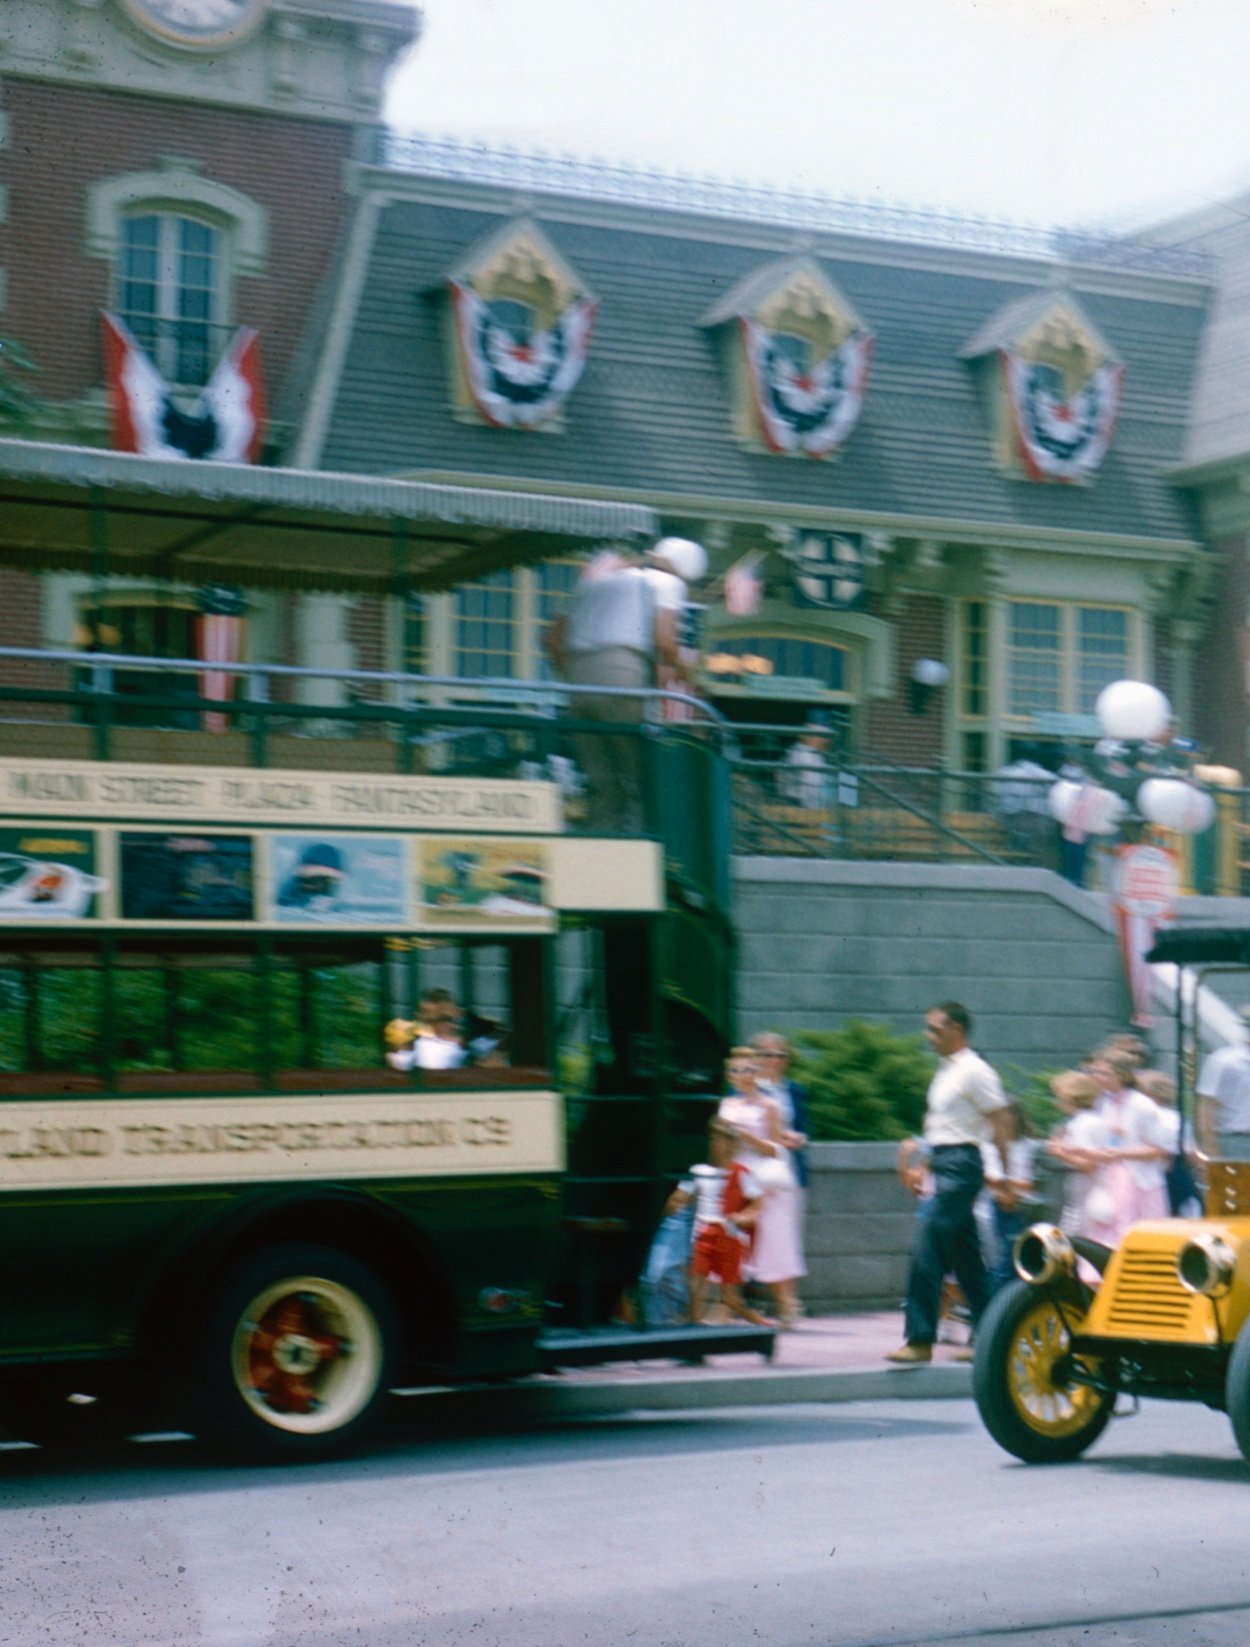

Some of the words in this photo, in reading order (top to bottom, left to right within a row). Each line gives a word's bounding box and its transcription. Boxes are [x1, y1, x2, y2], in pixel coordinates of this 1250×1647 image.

[9, 770, 86, 801] MAIN
[101, 773, 206, 807] STREET
[220, 779, 315, 811] PLAZA
[328, 783, 539, 819] FANTASYLAND
[118, 1120, 455, 1156] TRANSPORTATION
